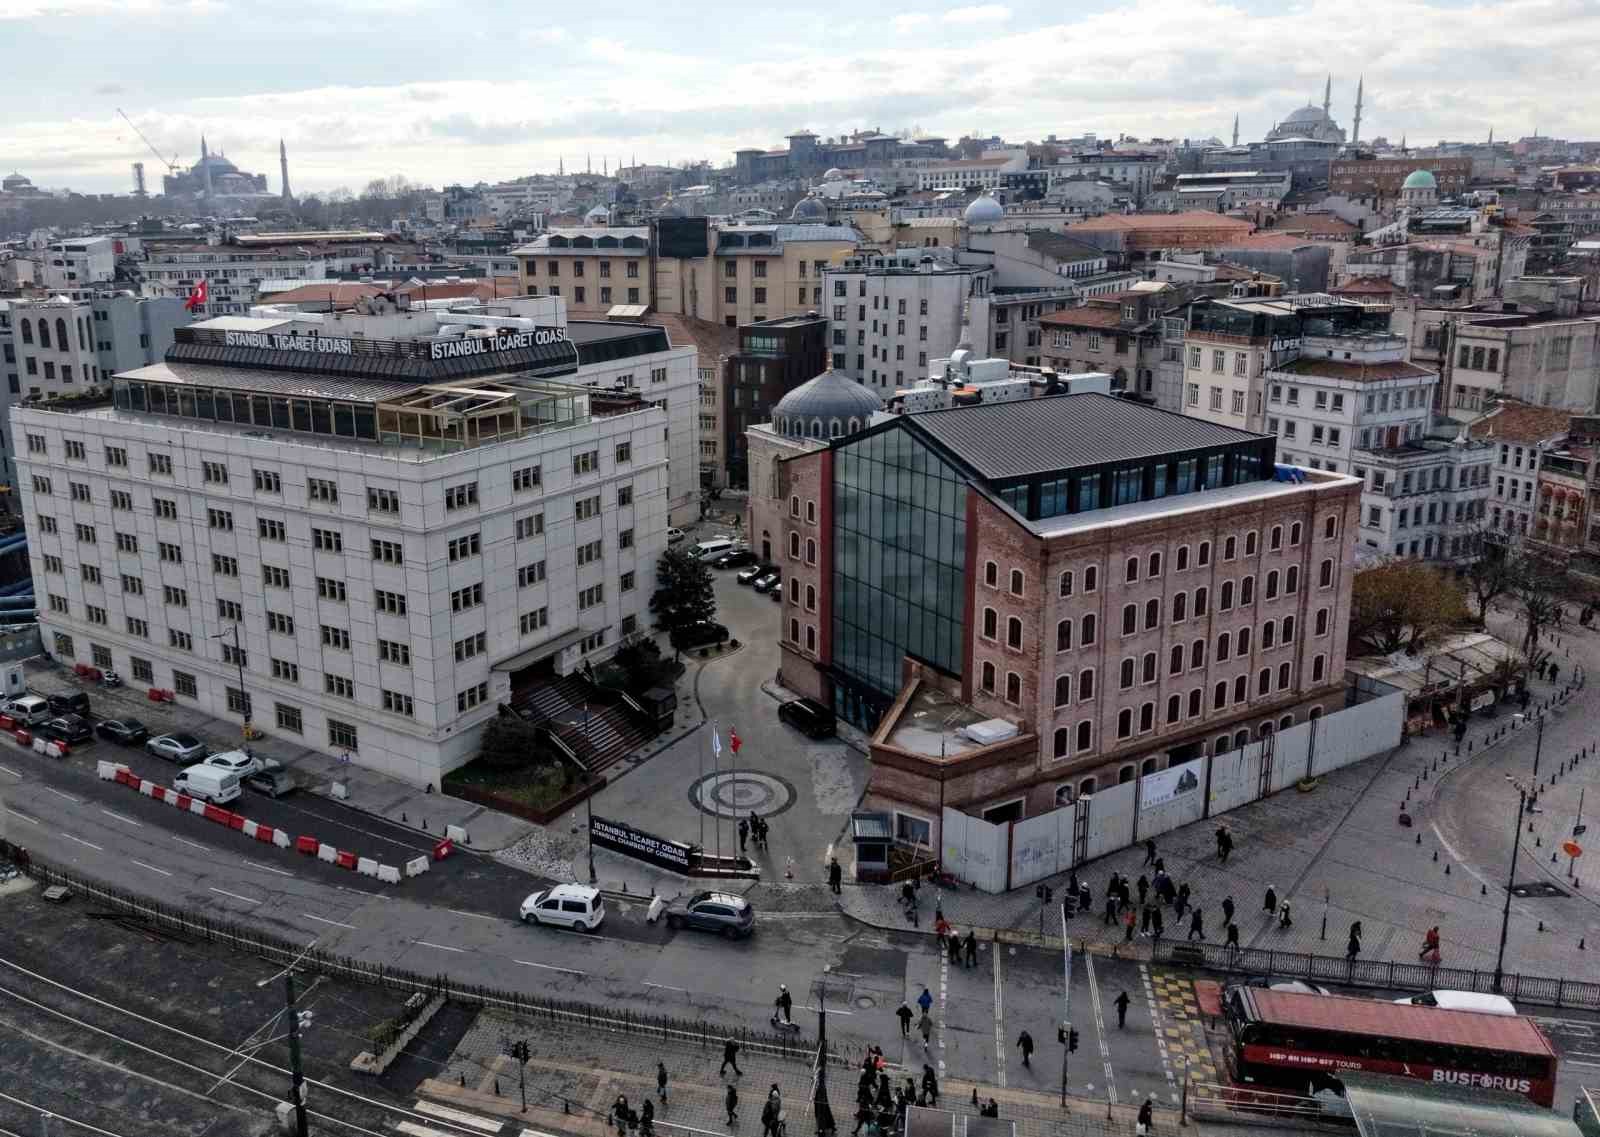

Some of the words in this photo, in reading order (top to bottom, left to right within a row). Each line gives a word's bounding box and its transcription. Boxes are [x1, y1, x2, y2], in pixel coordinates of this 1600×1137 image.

[535, 328, 567, 345] ODASI
[318, 338, 352, 355] ODASI
[592, 828, 617, 842] STANBUL
[630, 832, 660, 849] TİCARET
[661, 843, 686, 858] ODASI
[1335, 1059, 1362, 1069] TOURS
